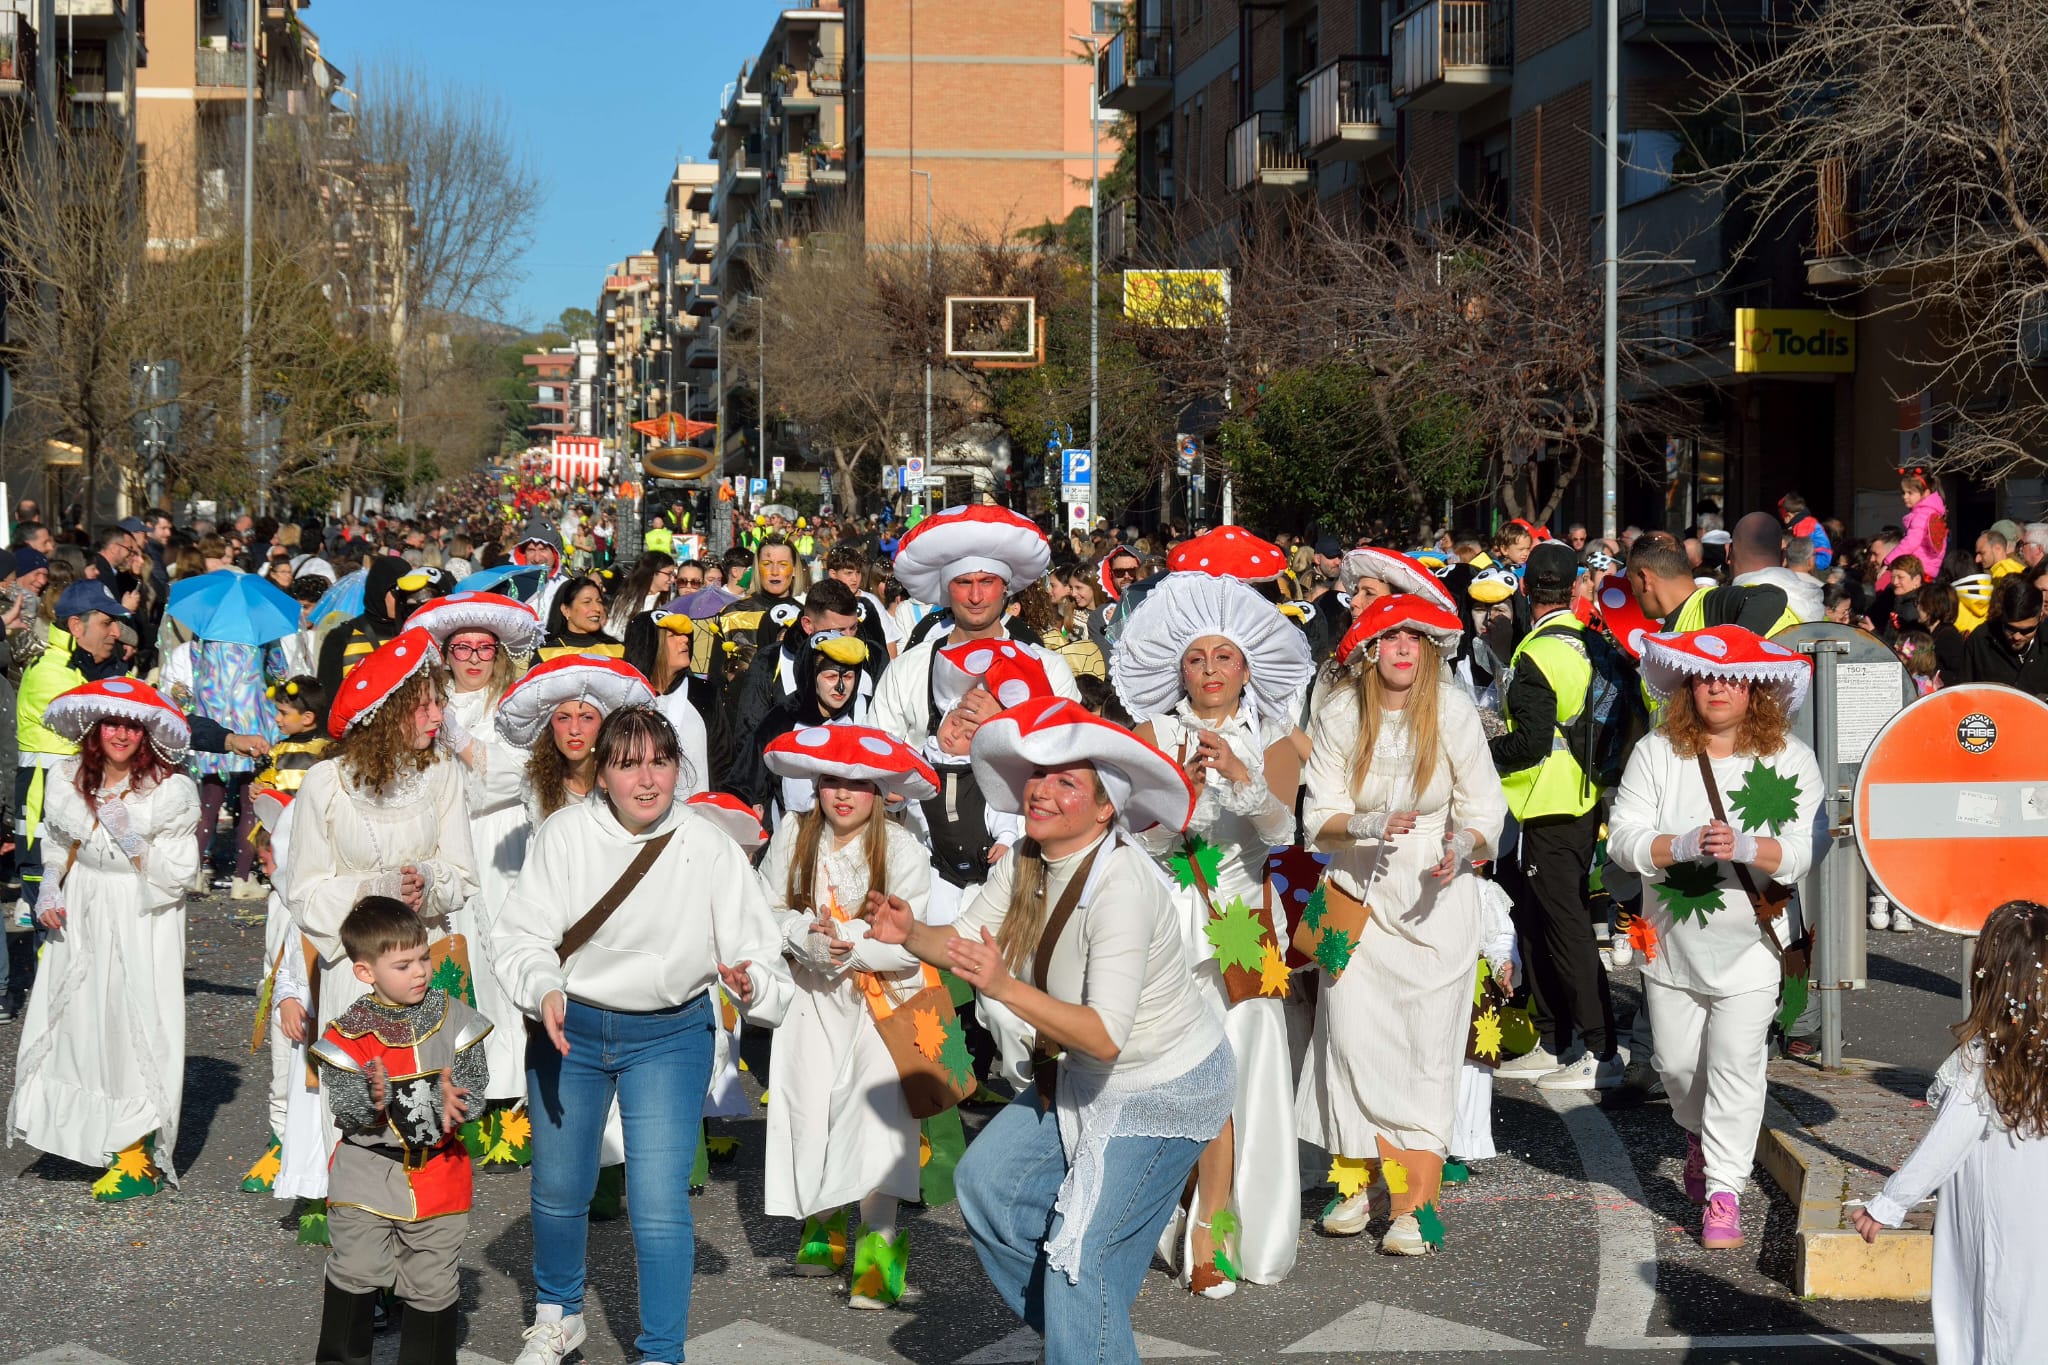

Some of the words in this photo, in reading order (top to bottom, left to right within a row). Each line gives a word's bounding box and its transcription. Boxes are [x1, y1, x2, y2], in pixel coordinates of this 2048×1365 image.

[1773, 328, 1849, 357] Todis
[1069, 453, 1091, 482] P
[754, 480, 764, 493] P
[1959, 728, 1995, 737] TRIBE
